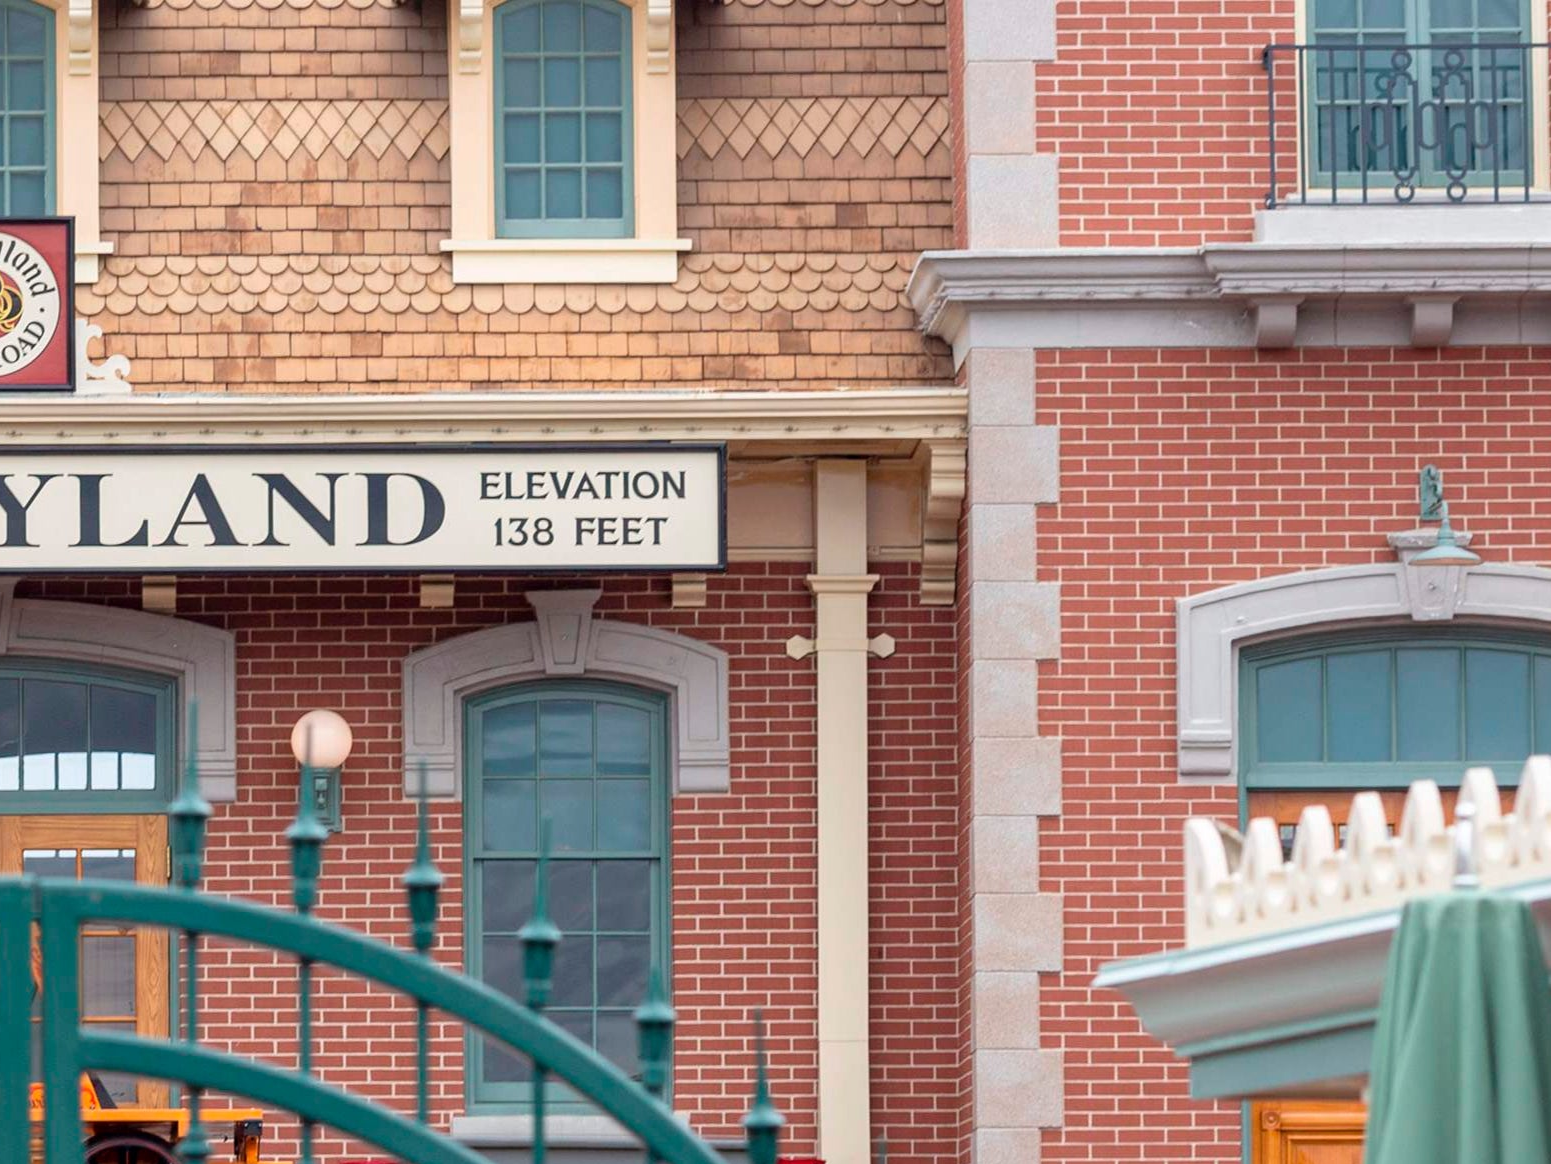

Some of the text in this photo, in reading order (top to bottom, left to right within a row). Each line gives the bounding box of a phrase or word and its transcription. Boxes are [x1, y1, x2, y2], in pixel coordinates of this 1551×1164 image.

[479, 470, 686, 500] ELEVATION
[494, 517, 669, 547] 138 FEET
